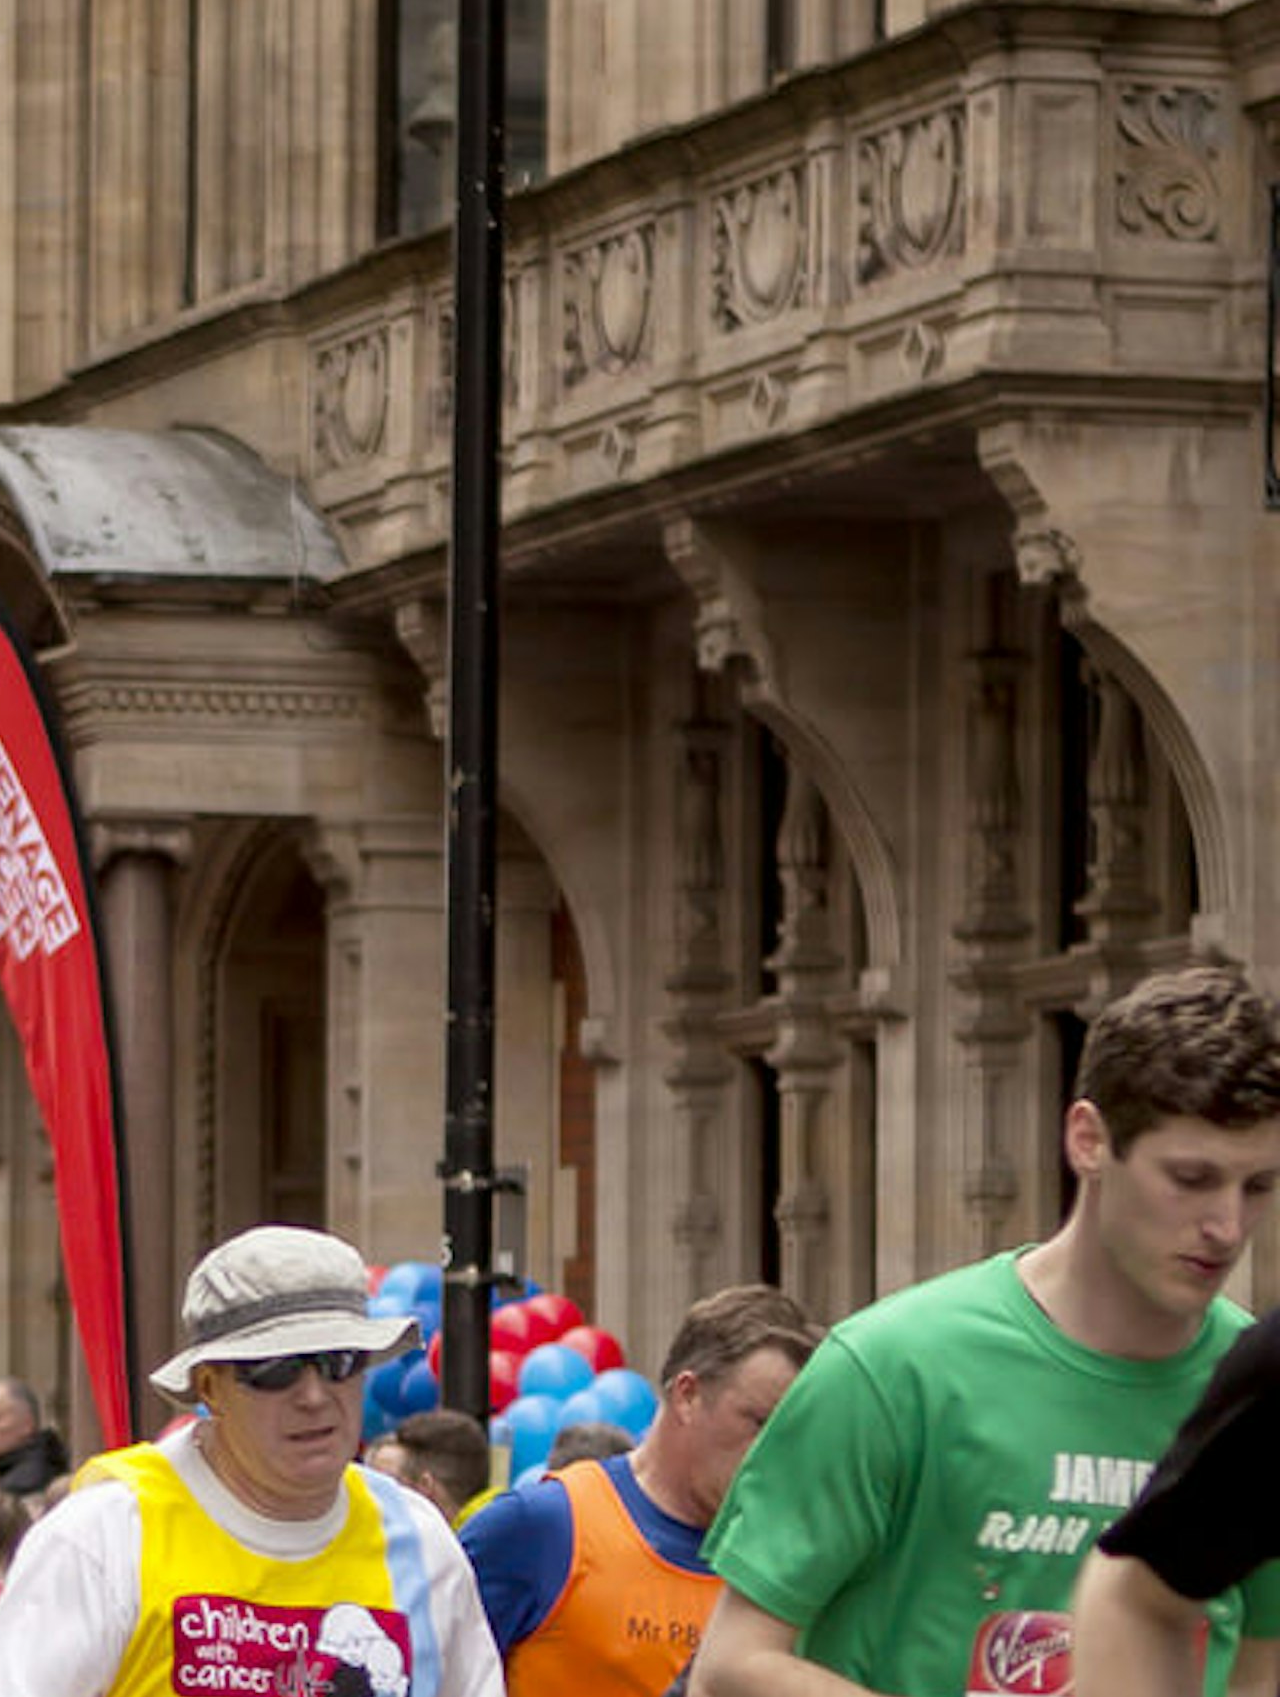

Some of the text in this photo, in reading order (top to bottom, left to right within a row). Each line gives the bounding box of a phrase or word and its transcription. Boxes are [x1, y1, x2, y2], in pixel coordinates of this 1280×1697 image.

[180, 1599, 309, 1652] children
[196, 1644, 238, 1664] with
[179, 1664, 274, 1693] cancer
